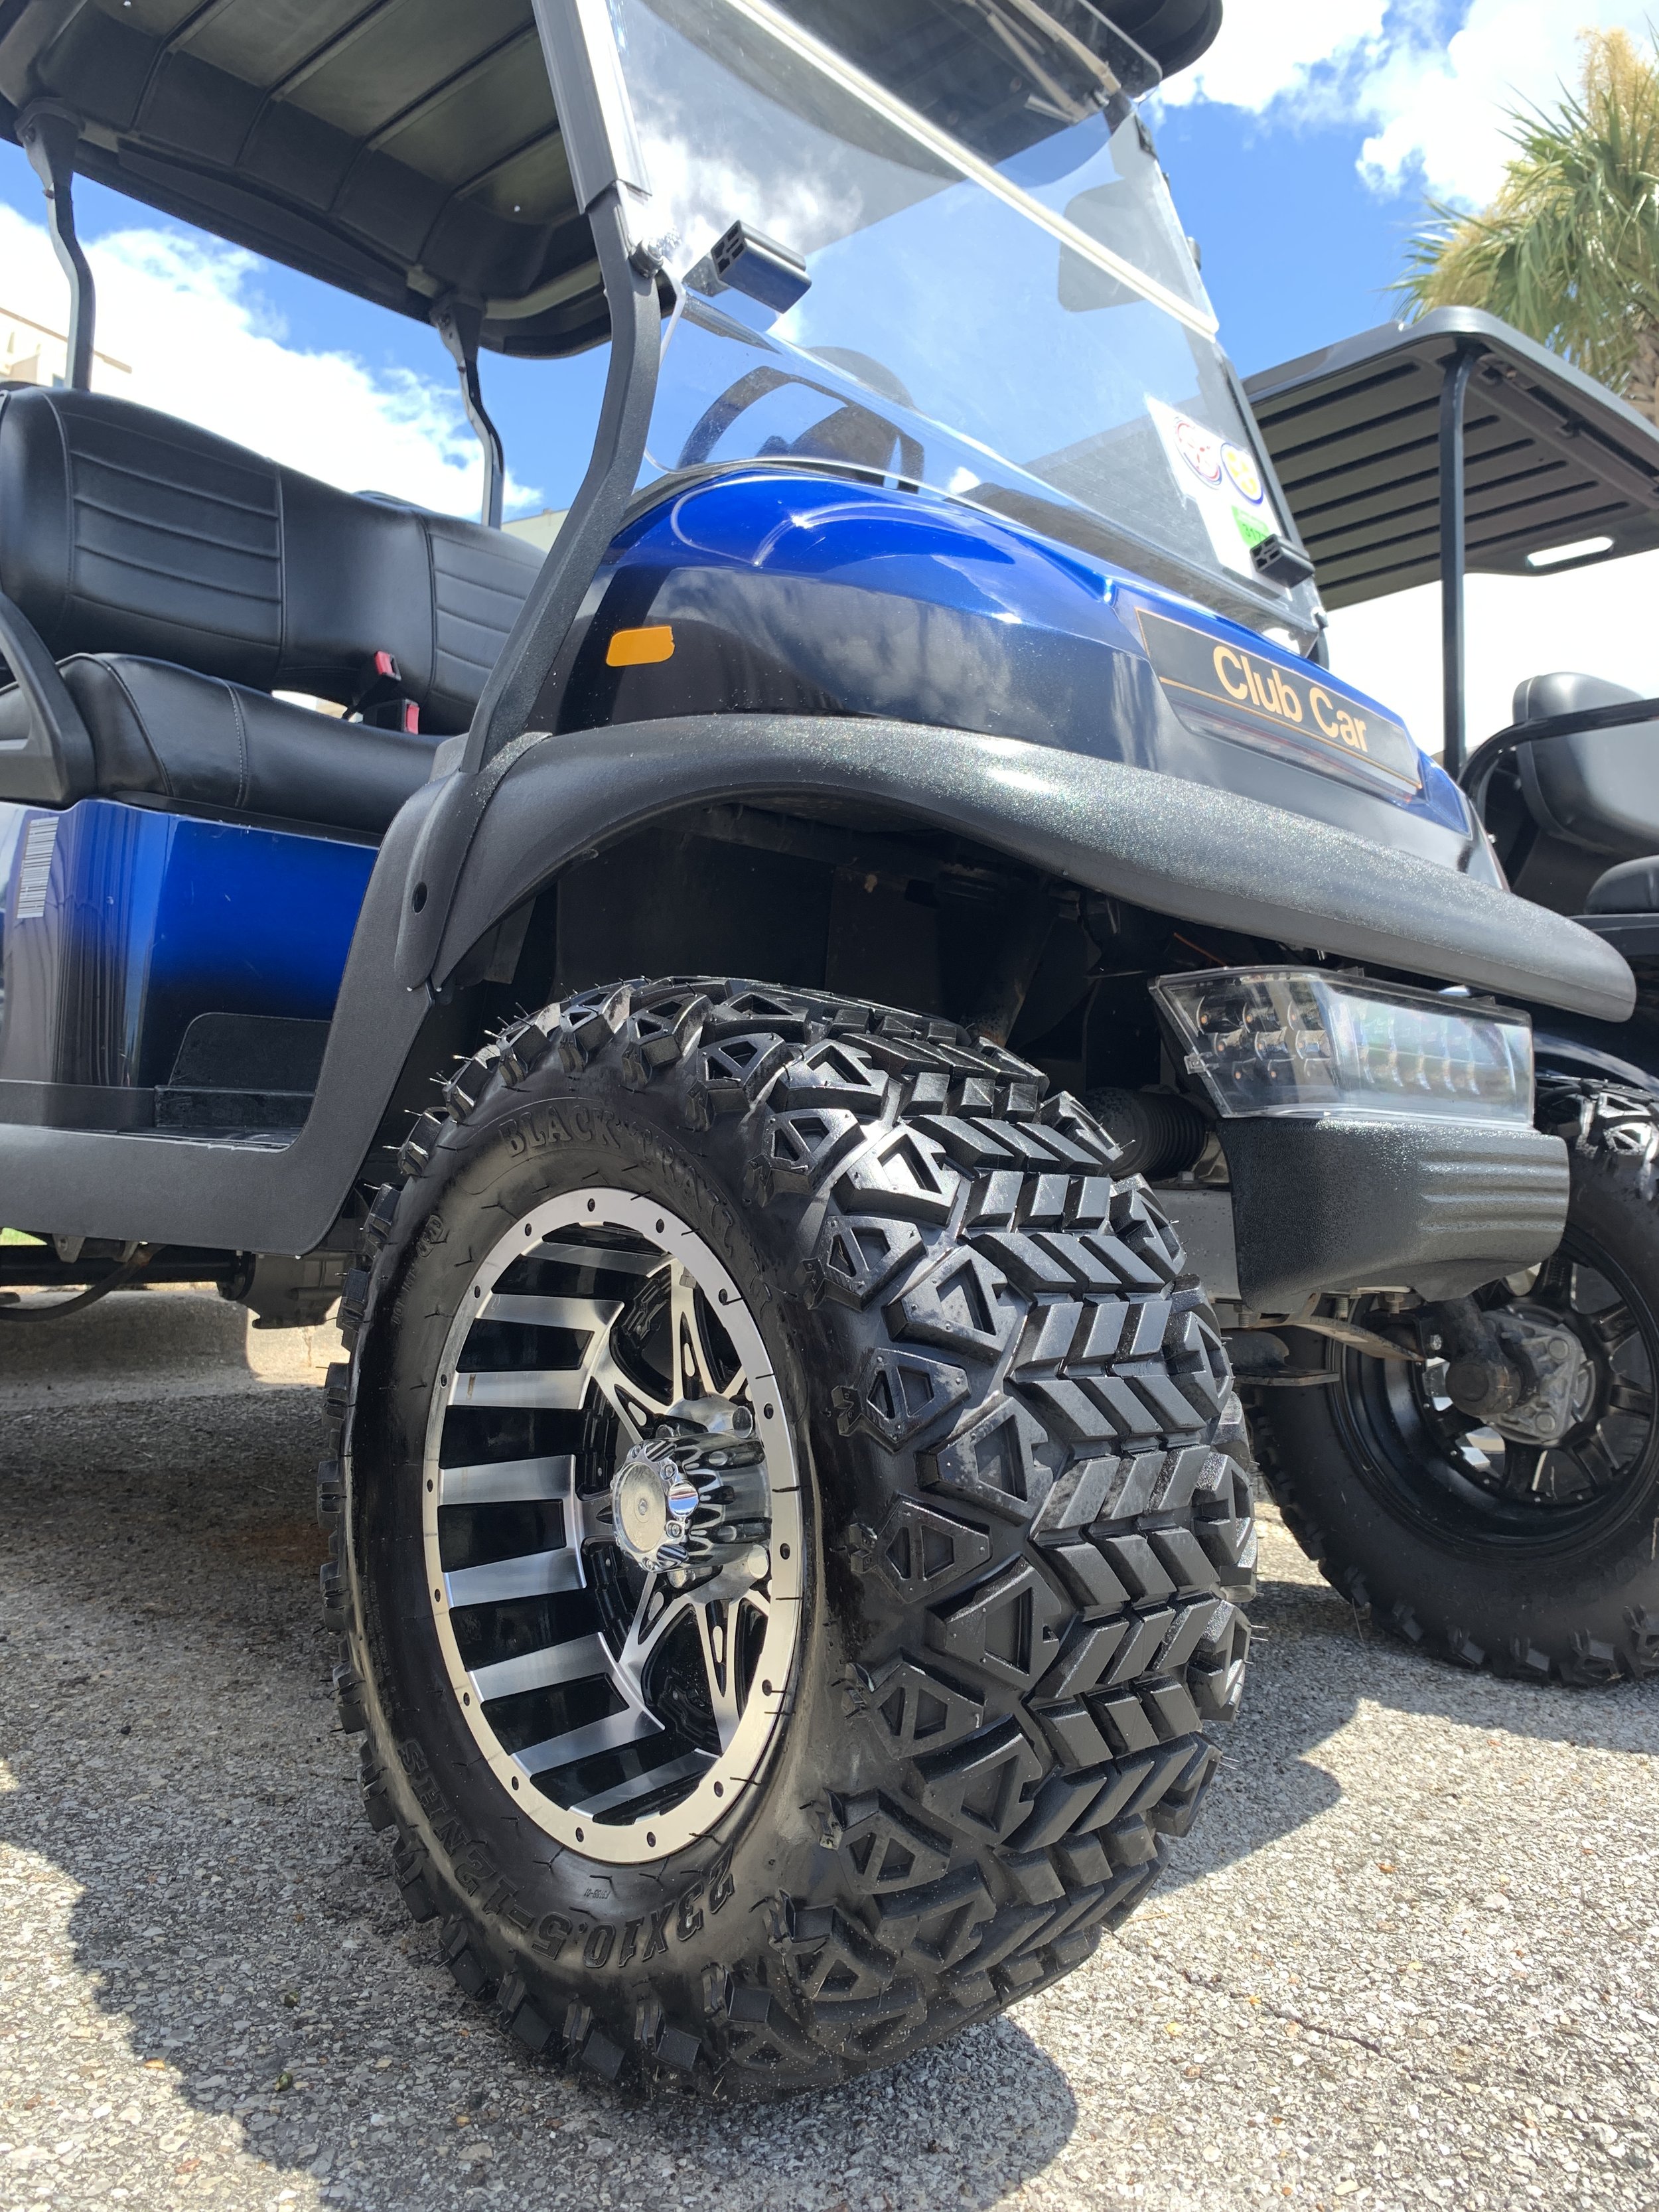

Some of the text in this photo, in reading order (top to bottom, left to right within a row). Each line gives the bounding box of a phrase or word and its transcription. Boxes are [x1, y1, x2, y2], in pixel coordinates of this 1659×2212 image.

[1213, 646, 1368, 753] Club Car
[499, 1105, 621, 1158] BLACK
